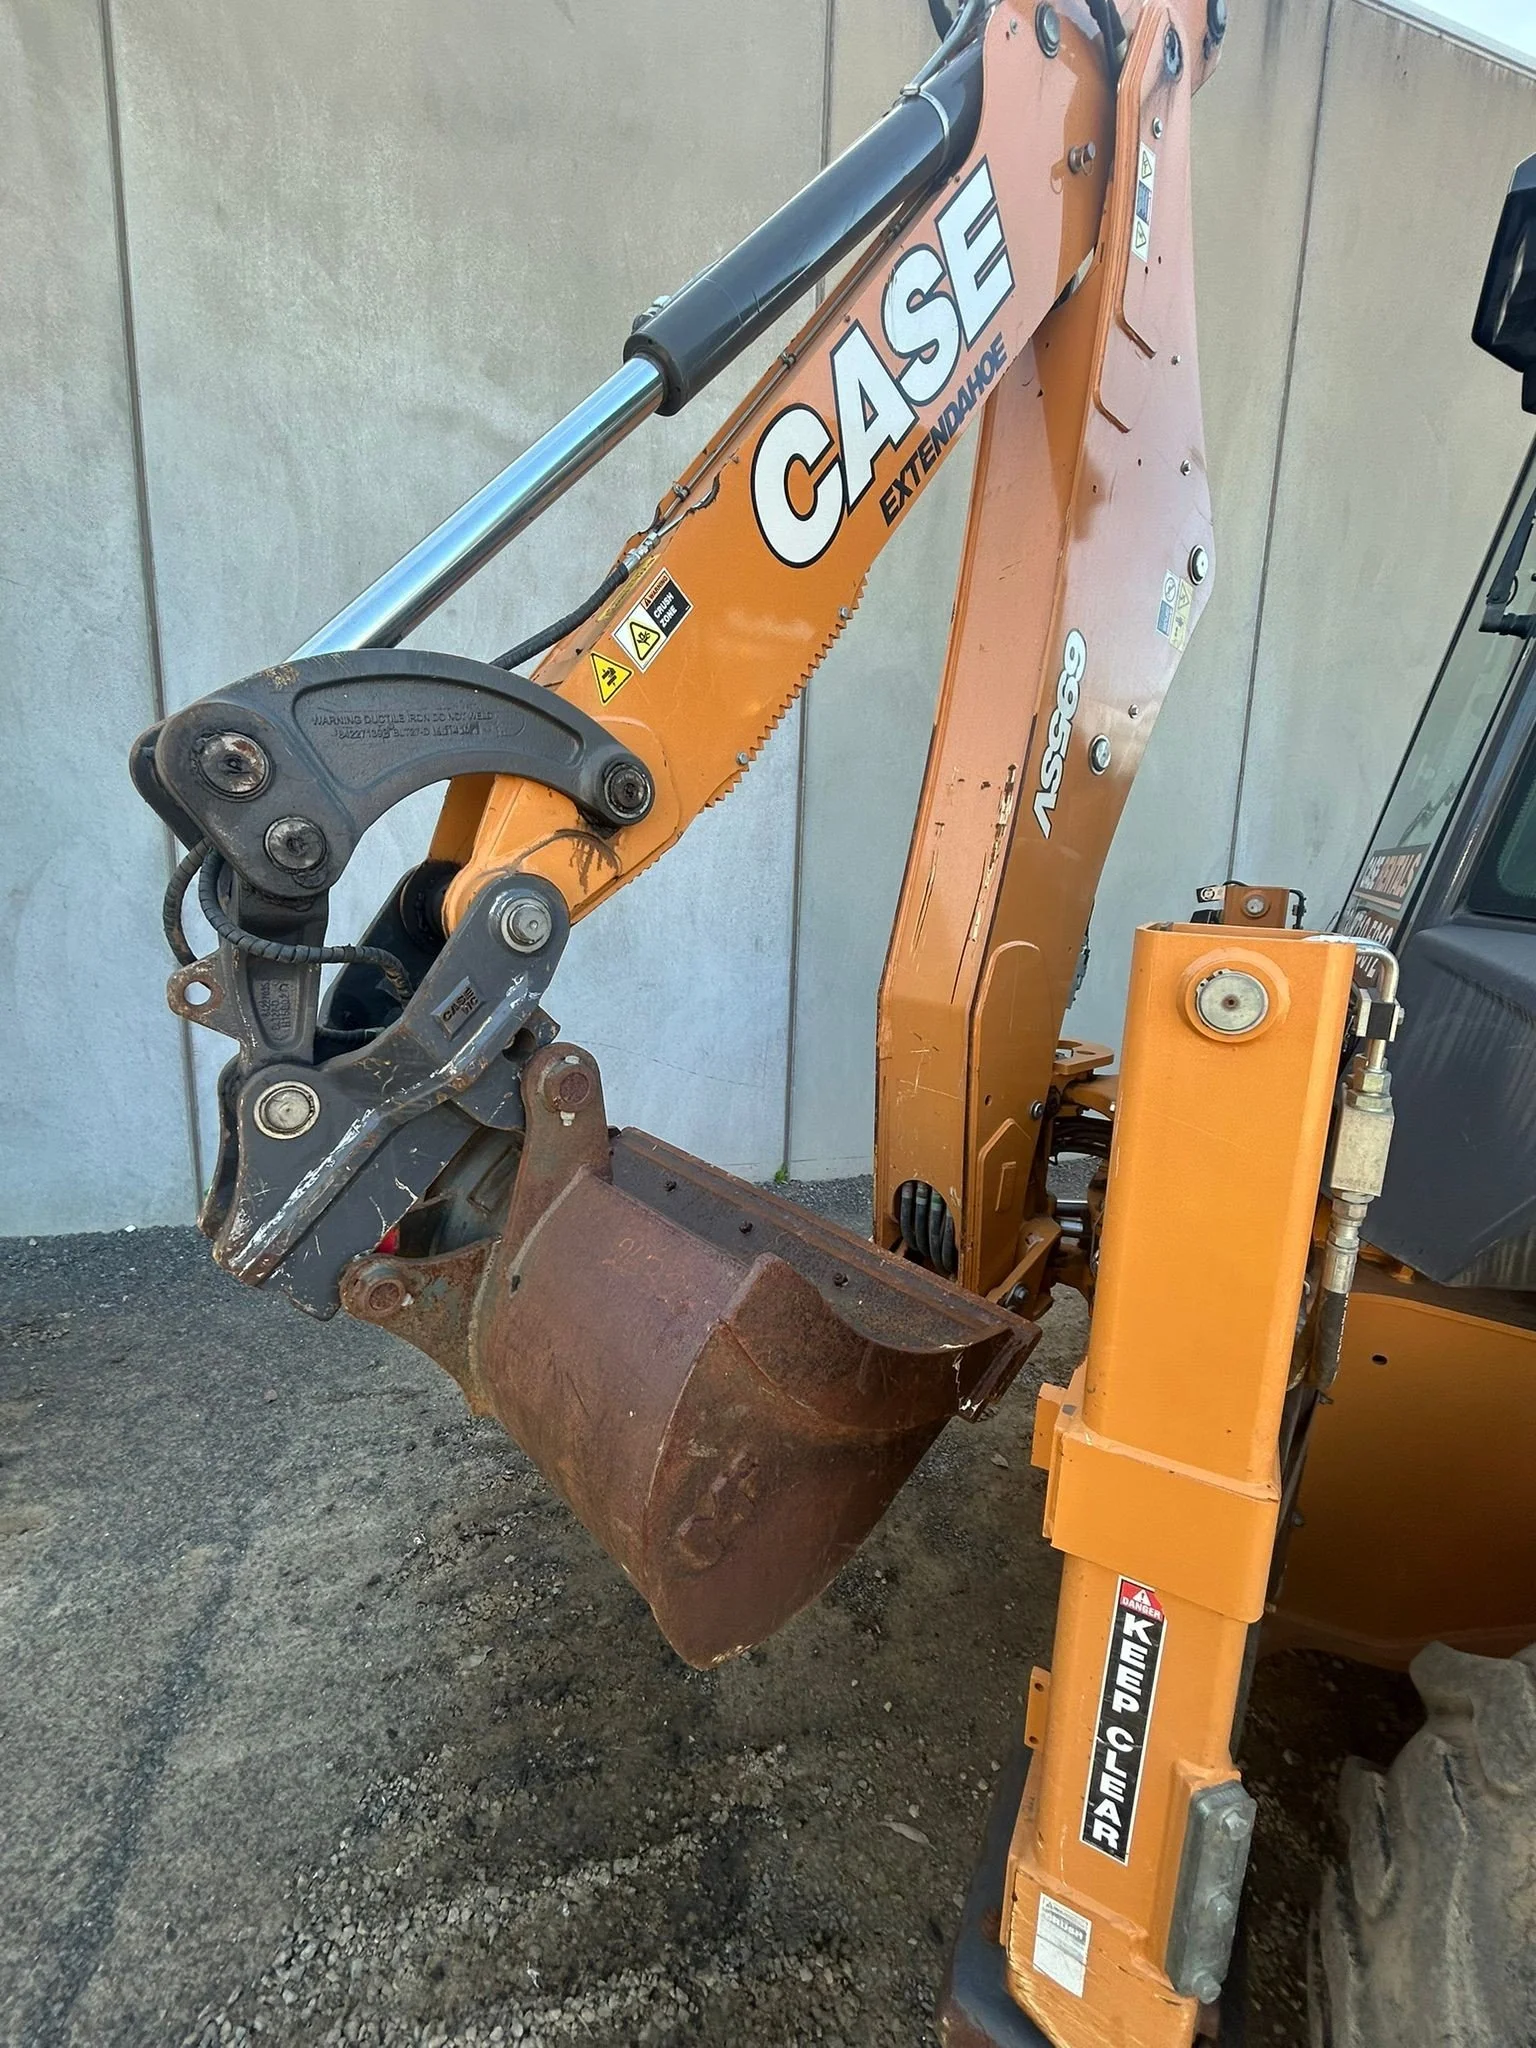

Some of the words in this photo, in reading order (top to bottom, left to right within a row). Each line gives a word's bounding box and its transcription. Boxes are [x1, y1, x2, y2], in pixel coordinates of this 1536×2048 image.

[751, 155, 1015, 569] CASE
[879, 332, 1008, 527] EXTENDAHOE
[653, 592, 675, 619] CRUSH
[660, 605, 678, 628] ZONE
[1033, 627, 1087, 839] 695SV
[443, 986, 475, 1021] CASE
[1121, 1596, 1162, 1619] DANGER
[1112, 1612, 1154, 1714] KEEP
[1092, 1726, 1135, 1850] CLEAR
